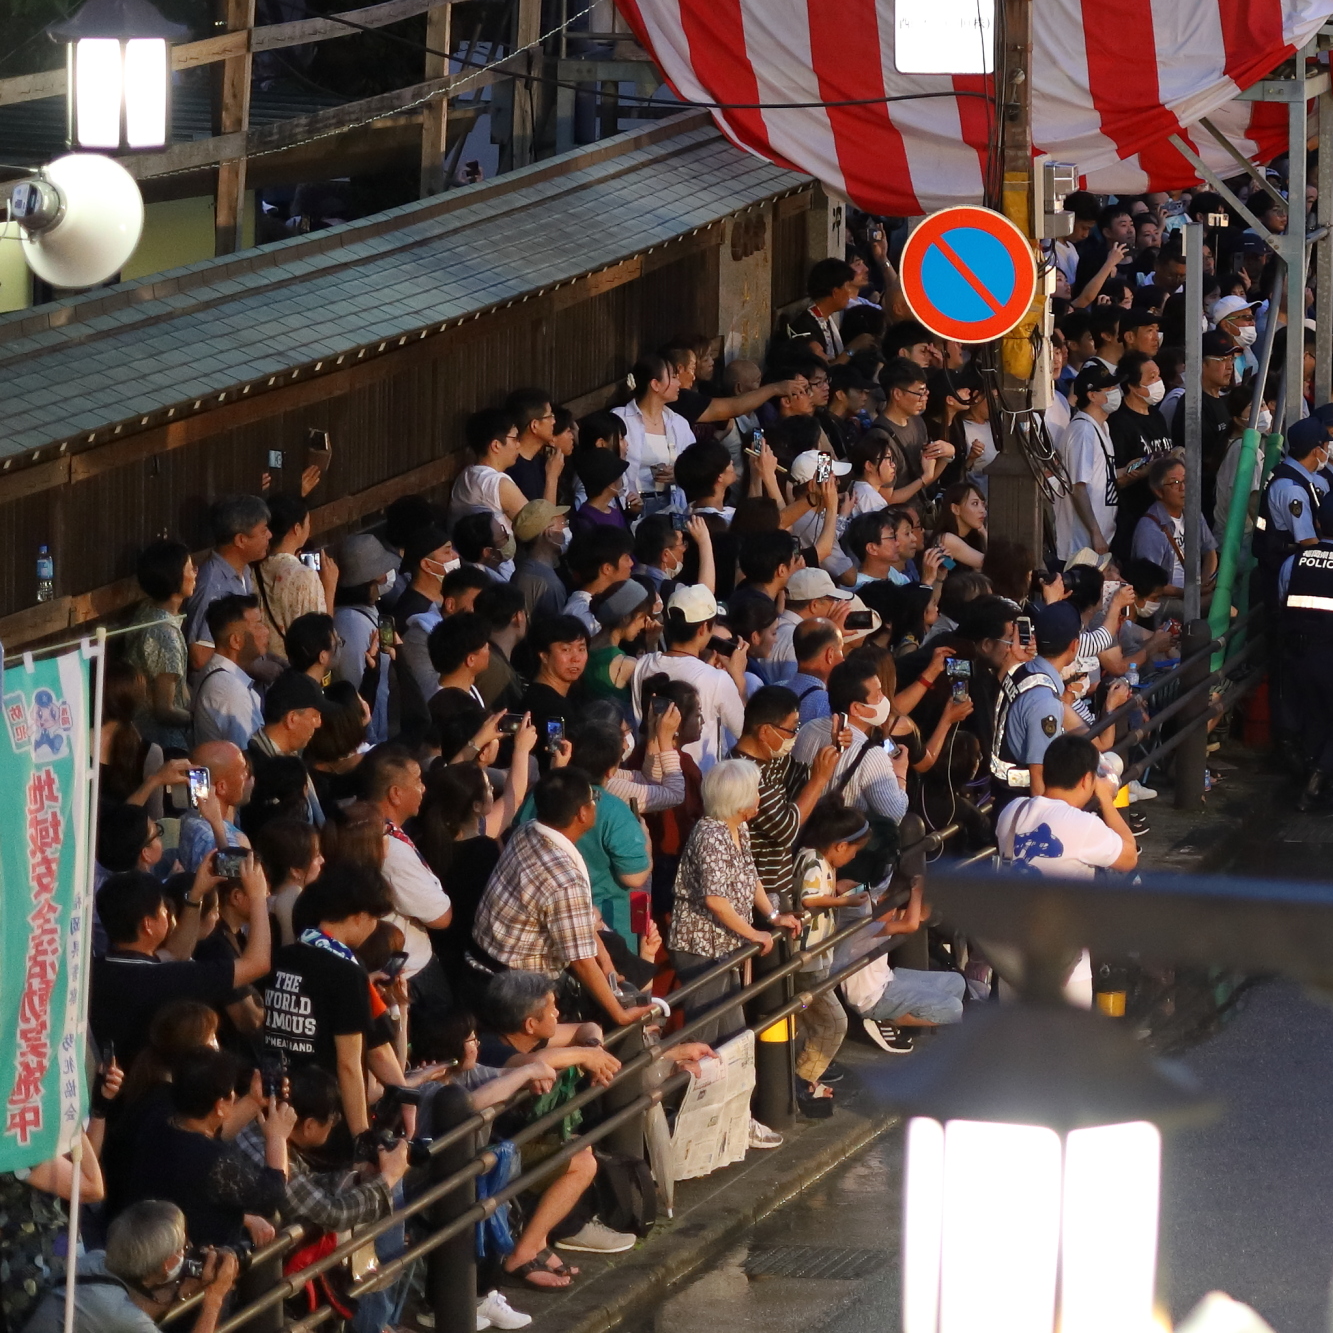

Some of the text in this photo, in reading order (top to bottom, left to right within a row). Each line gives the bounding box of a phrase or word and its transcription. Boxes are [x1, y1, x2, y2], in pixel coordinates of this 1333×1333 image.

[275, 971, 302, 993] THE
[265, 988, 312, 1015] WORLD
[265, 1010, 317, 1035] AMOUS
